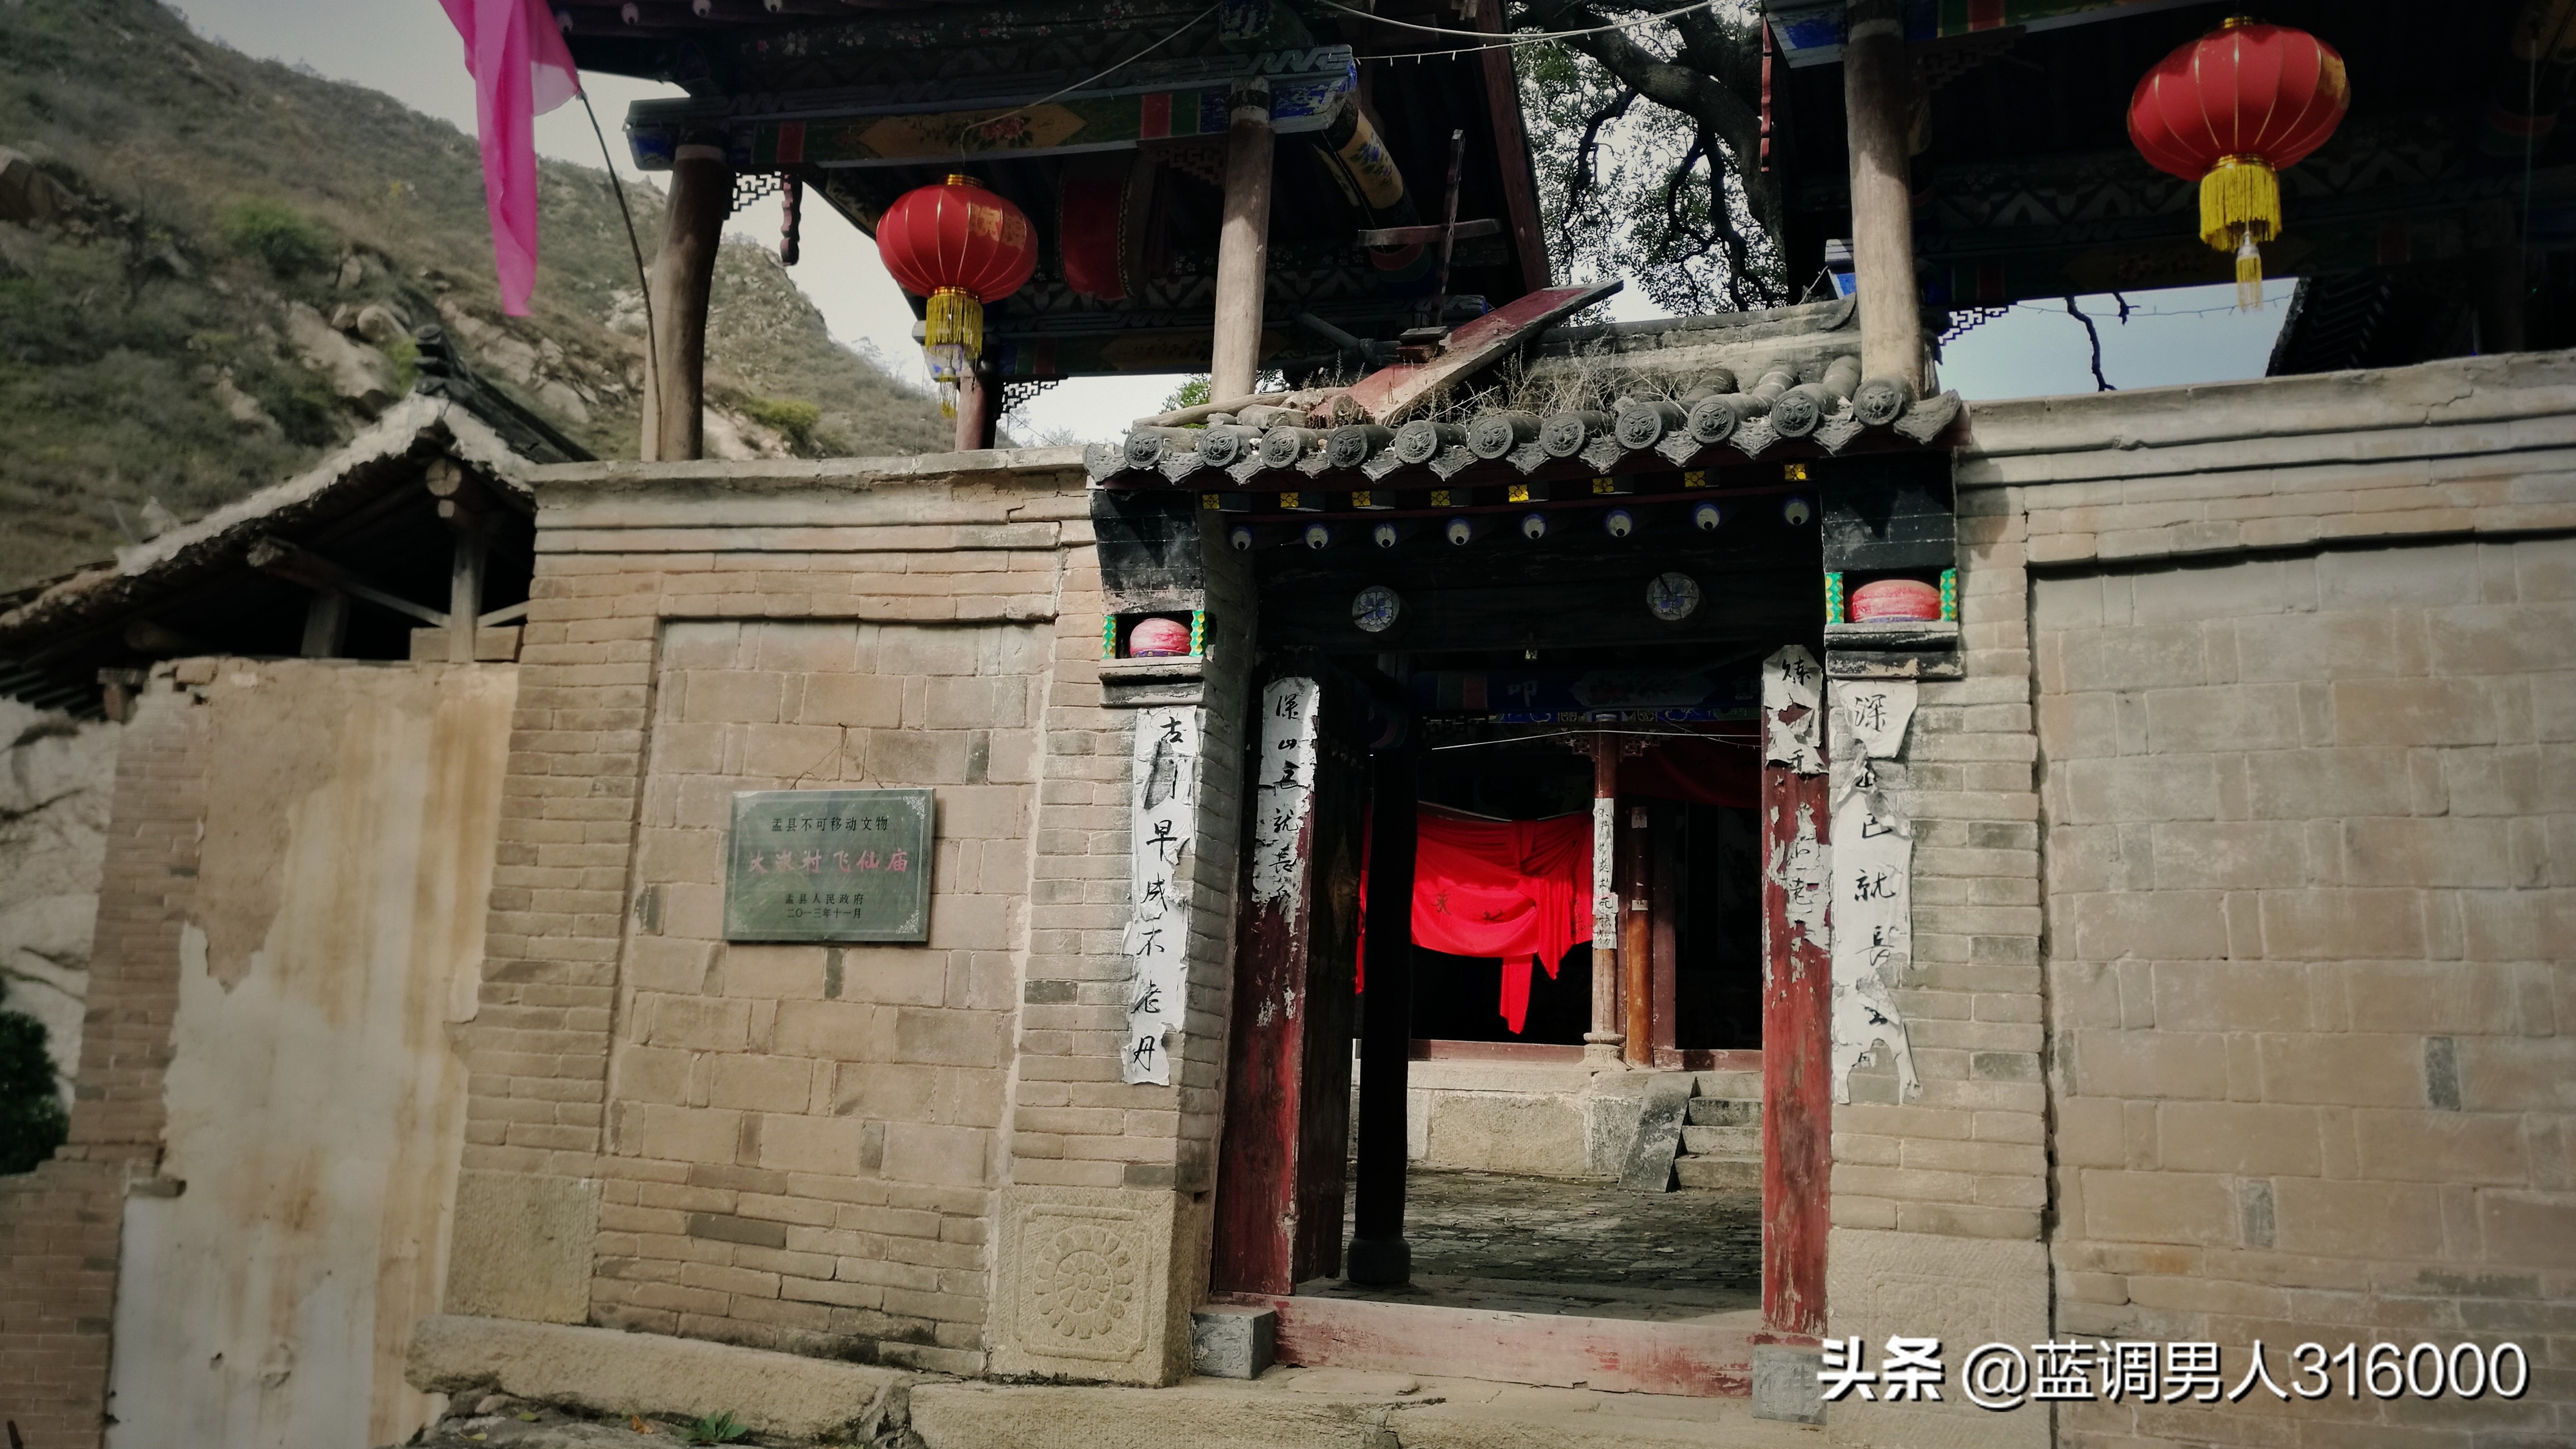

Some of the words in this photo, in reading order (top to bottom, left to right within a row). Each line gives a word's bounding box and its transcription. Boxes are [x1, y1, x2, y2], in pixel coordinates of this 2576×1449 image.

[771, 816, 888, 832] 盂县不可移动文物
[785, 893, 864, 905] 盂县人民政府
[1131, 716, 1184, 1072] 古早成不老丹
[787, 908, 861, 919] 二〇一三年十一月
